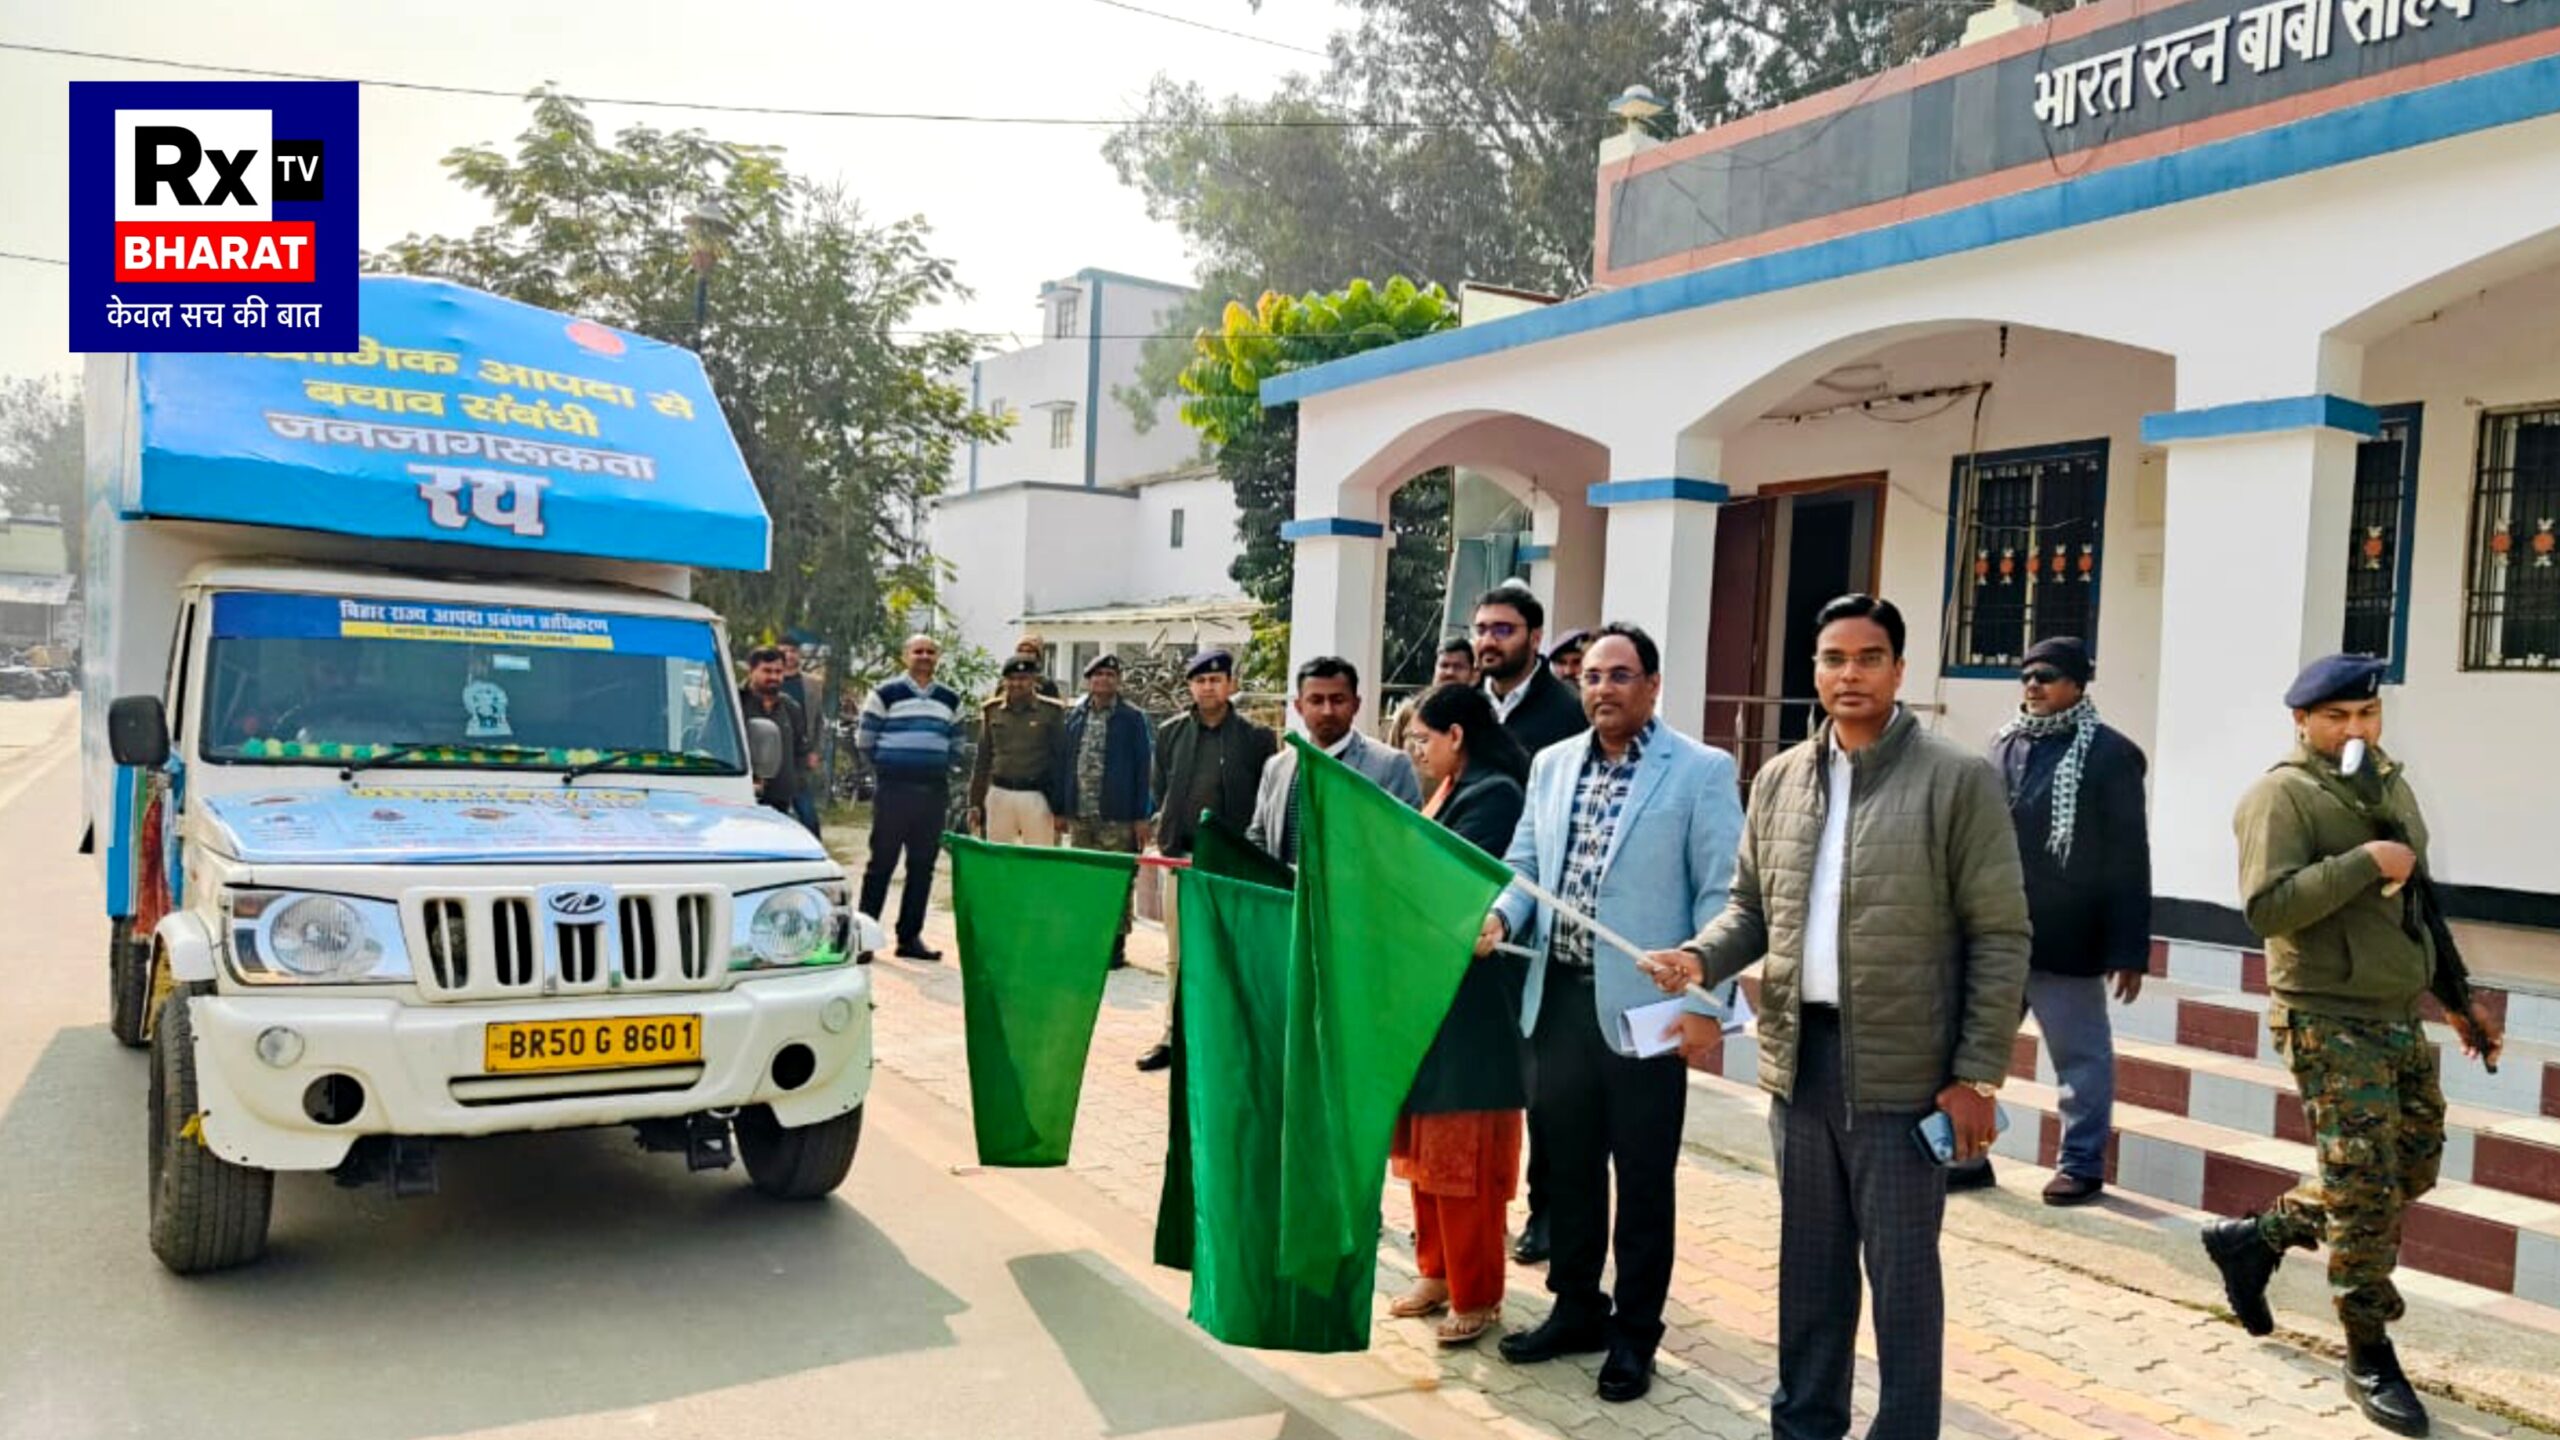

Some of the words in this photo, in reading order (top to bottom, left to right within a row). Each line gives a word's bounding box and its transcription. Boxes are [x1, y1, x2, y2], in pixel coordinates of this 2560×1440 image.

[2034, 45, 2139, 127] भारत
[2142, 15, 2232, 99] रत्न
[2237, 0, 2332, 73] बाबा
[303, 379, 445, 416] बचाव
[458, 392, 601, 437] संबंधी
[478, 358, 635, 409] आपदा
[646, 389, 696, 421] से
[509, 1028, 586, 1059] BR50
[595, 1026, 611, 1053] G
[623, 1022, 694, 1052] 8601
